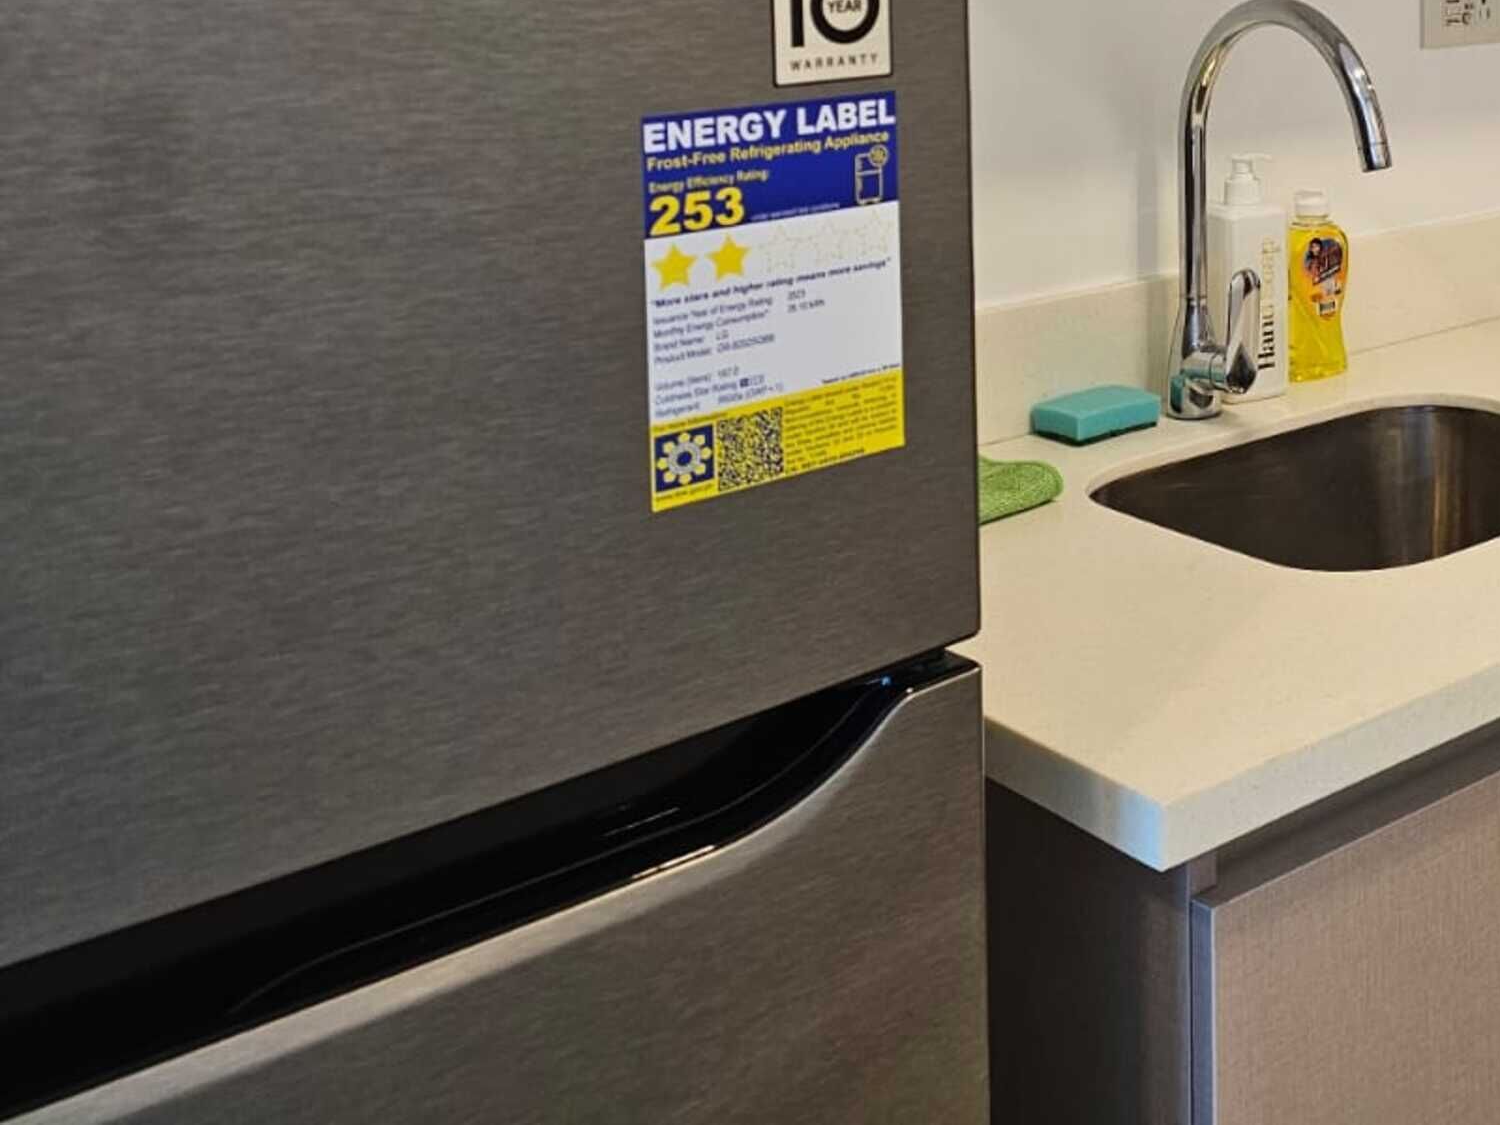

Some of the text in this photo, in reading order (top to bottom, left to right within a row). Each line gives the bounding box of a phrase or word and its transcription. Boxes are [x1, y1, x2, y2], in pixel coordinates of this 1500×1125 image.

[828, 0, 861, 13] YEAR
[790, 54, 878, 71] WARRANTY
[643, 98, 896, 154] ENERGY LABEL
[647, 131, 889, 172] Frost-Free Refrigerating Appliance
[648, 181, 685, 194] Energy
[687, 174, 735, 190] Efficiency
[649, 186, 745, 237] 253
